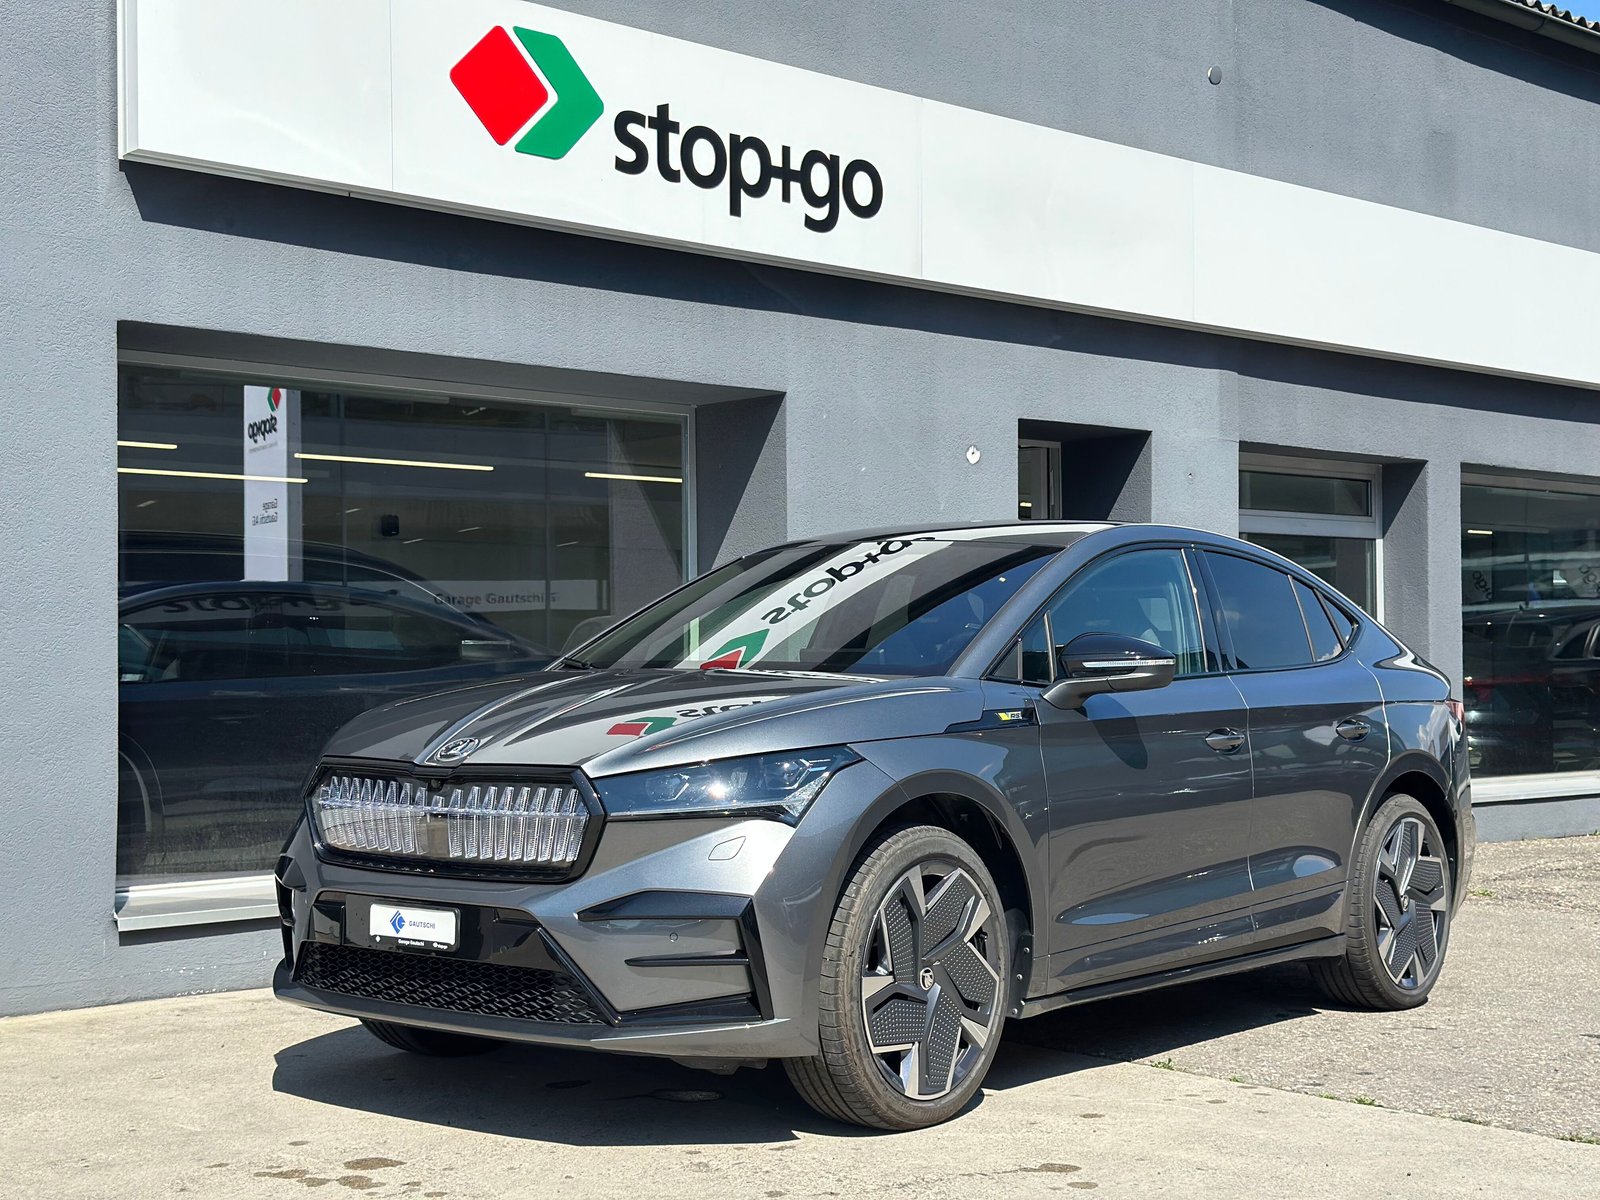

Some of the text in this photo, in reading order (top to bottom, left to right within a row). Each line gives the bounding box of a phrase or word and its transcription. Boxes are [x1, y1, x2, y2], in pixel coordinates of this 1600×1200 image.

[613, 103, 884, 233] stop+go
[433, 593, 481, 608] Garage
[486, 592, 545, 605] Gautschi
[409, 920, 435, 929] GAUTSCHI
